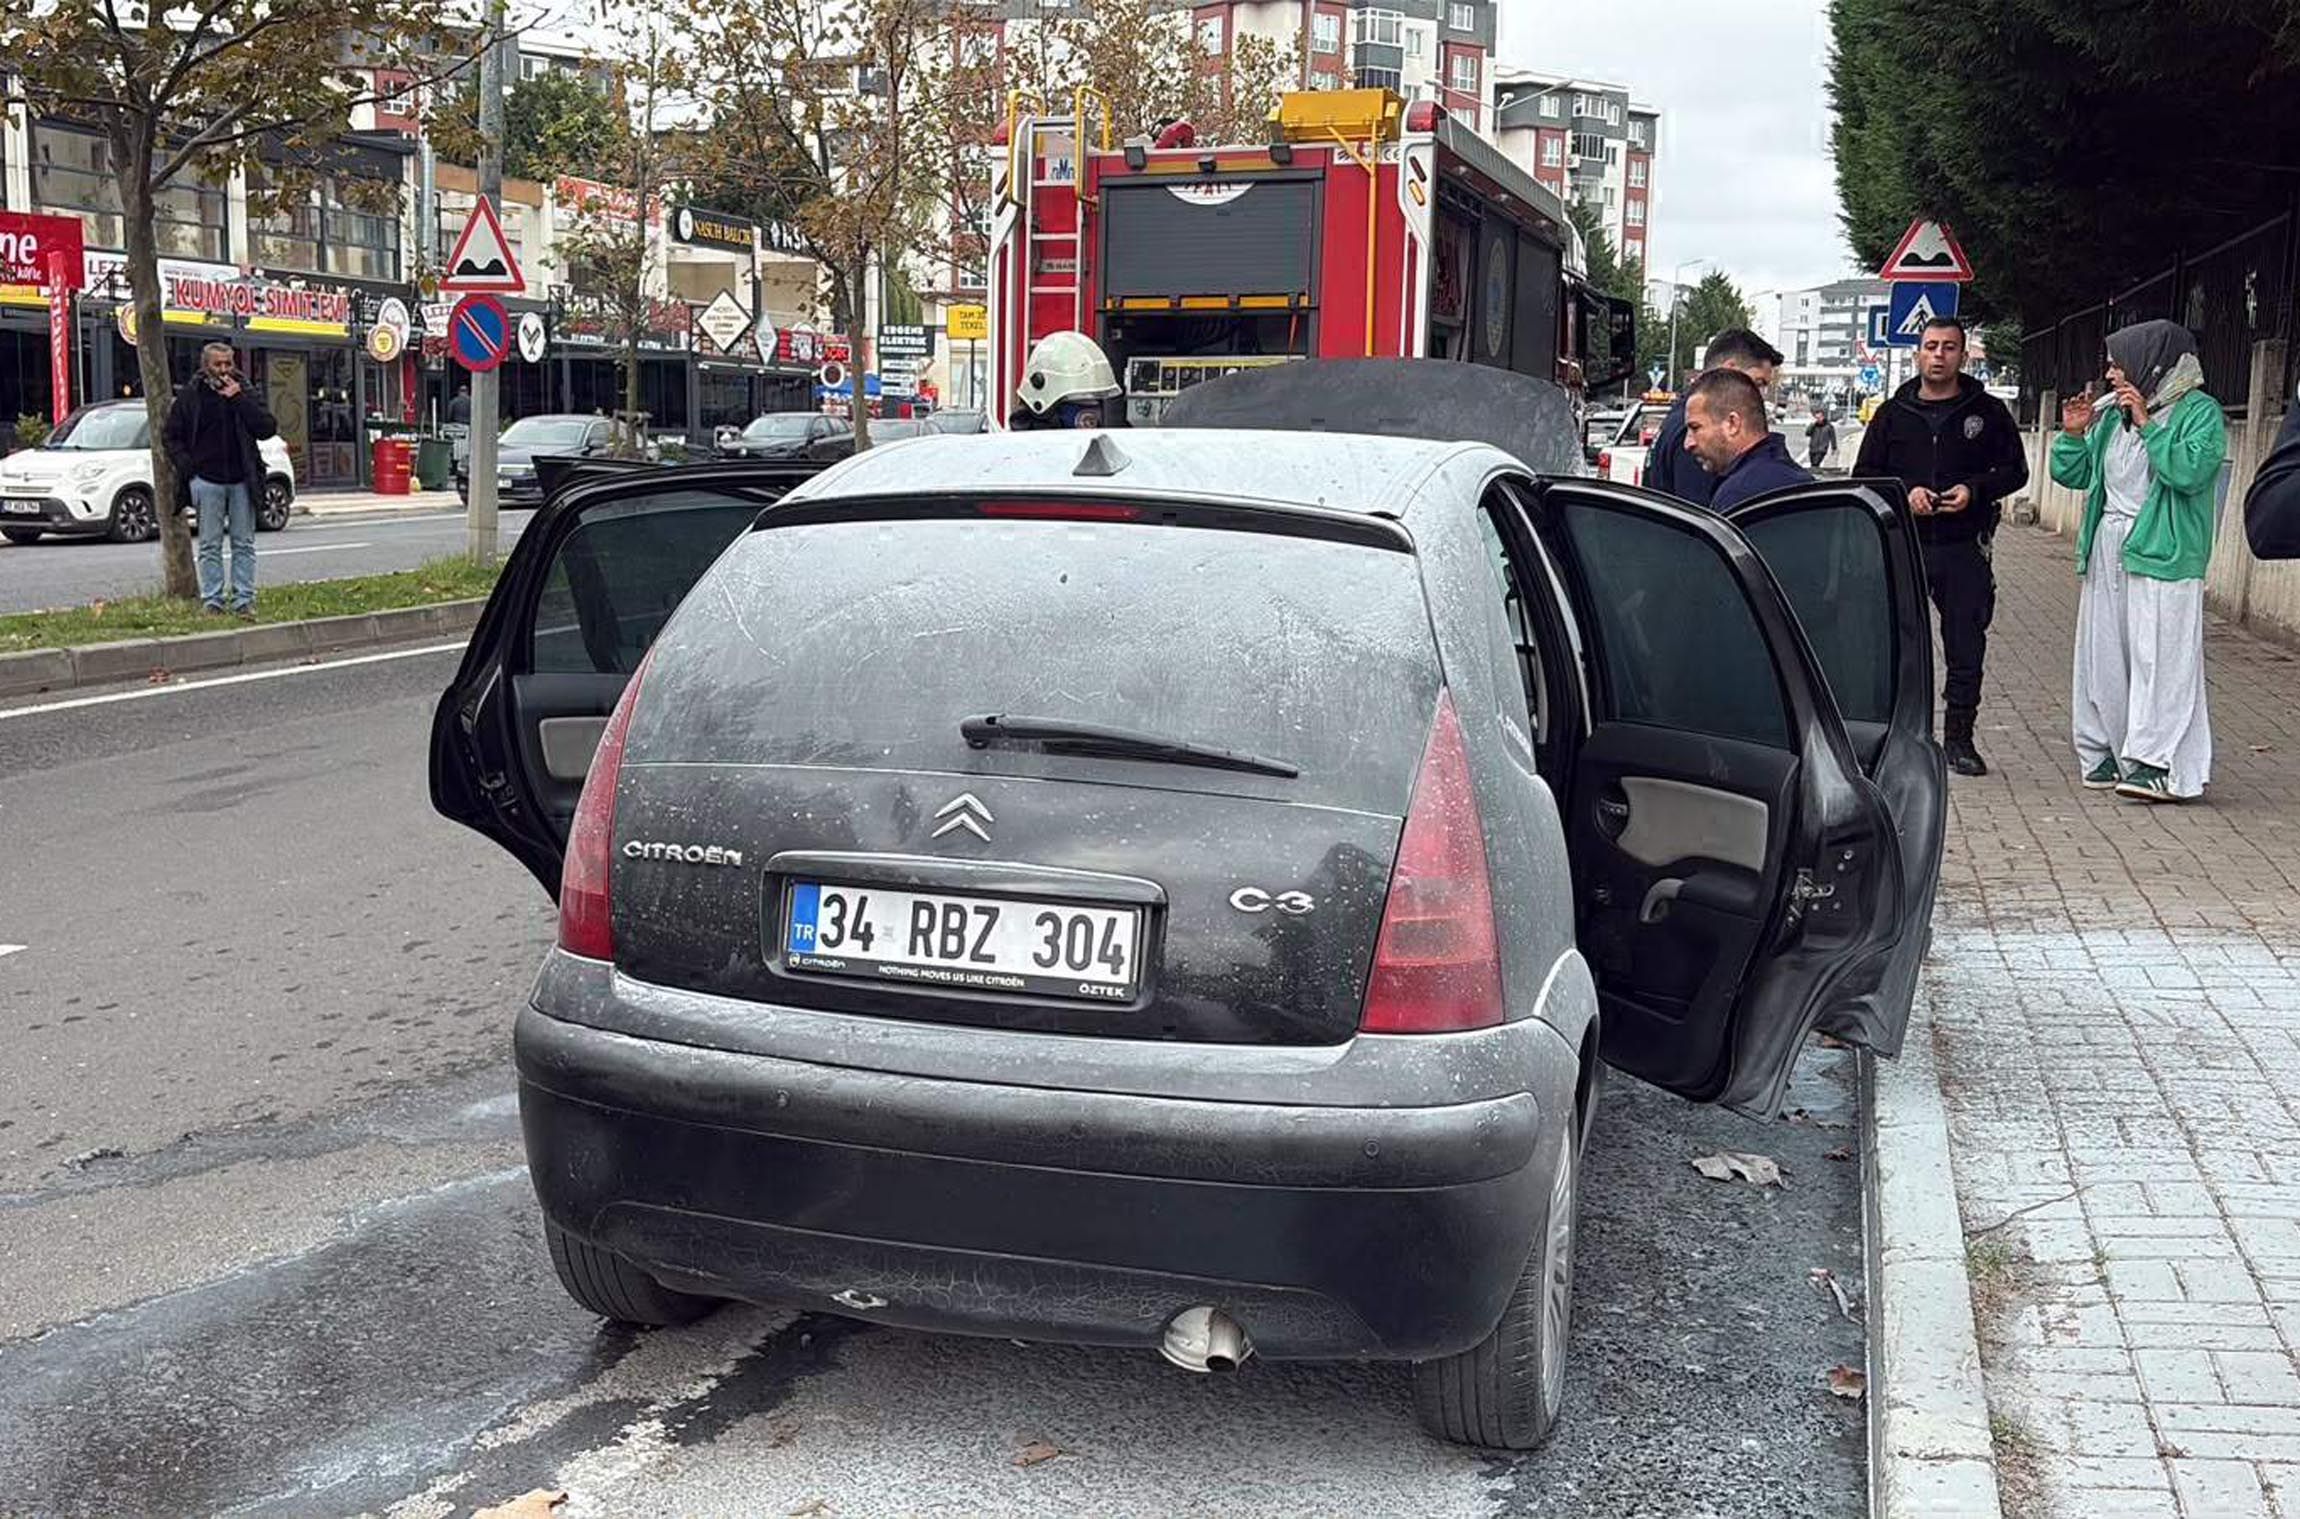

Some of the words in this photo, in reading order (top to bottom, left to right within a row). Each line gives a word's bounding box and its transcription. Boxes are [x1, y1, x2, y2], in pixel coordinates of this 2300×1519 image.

[623, 841, 742, 866] CITROËN
[1230, 887, 1314, 914] C3
[795, 923, 815, 941] TR
[820, 893, 874, 952] 34
[908, 900, 1000, 964] RBZ
[1032, 911, 1125, 975] 304
[878, 965, 918, 978] NOTHING
[920, 970, 950, 982] MOVES
[952, 973, 966, 983] US
[966, 974, 985, 985] LIKE
